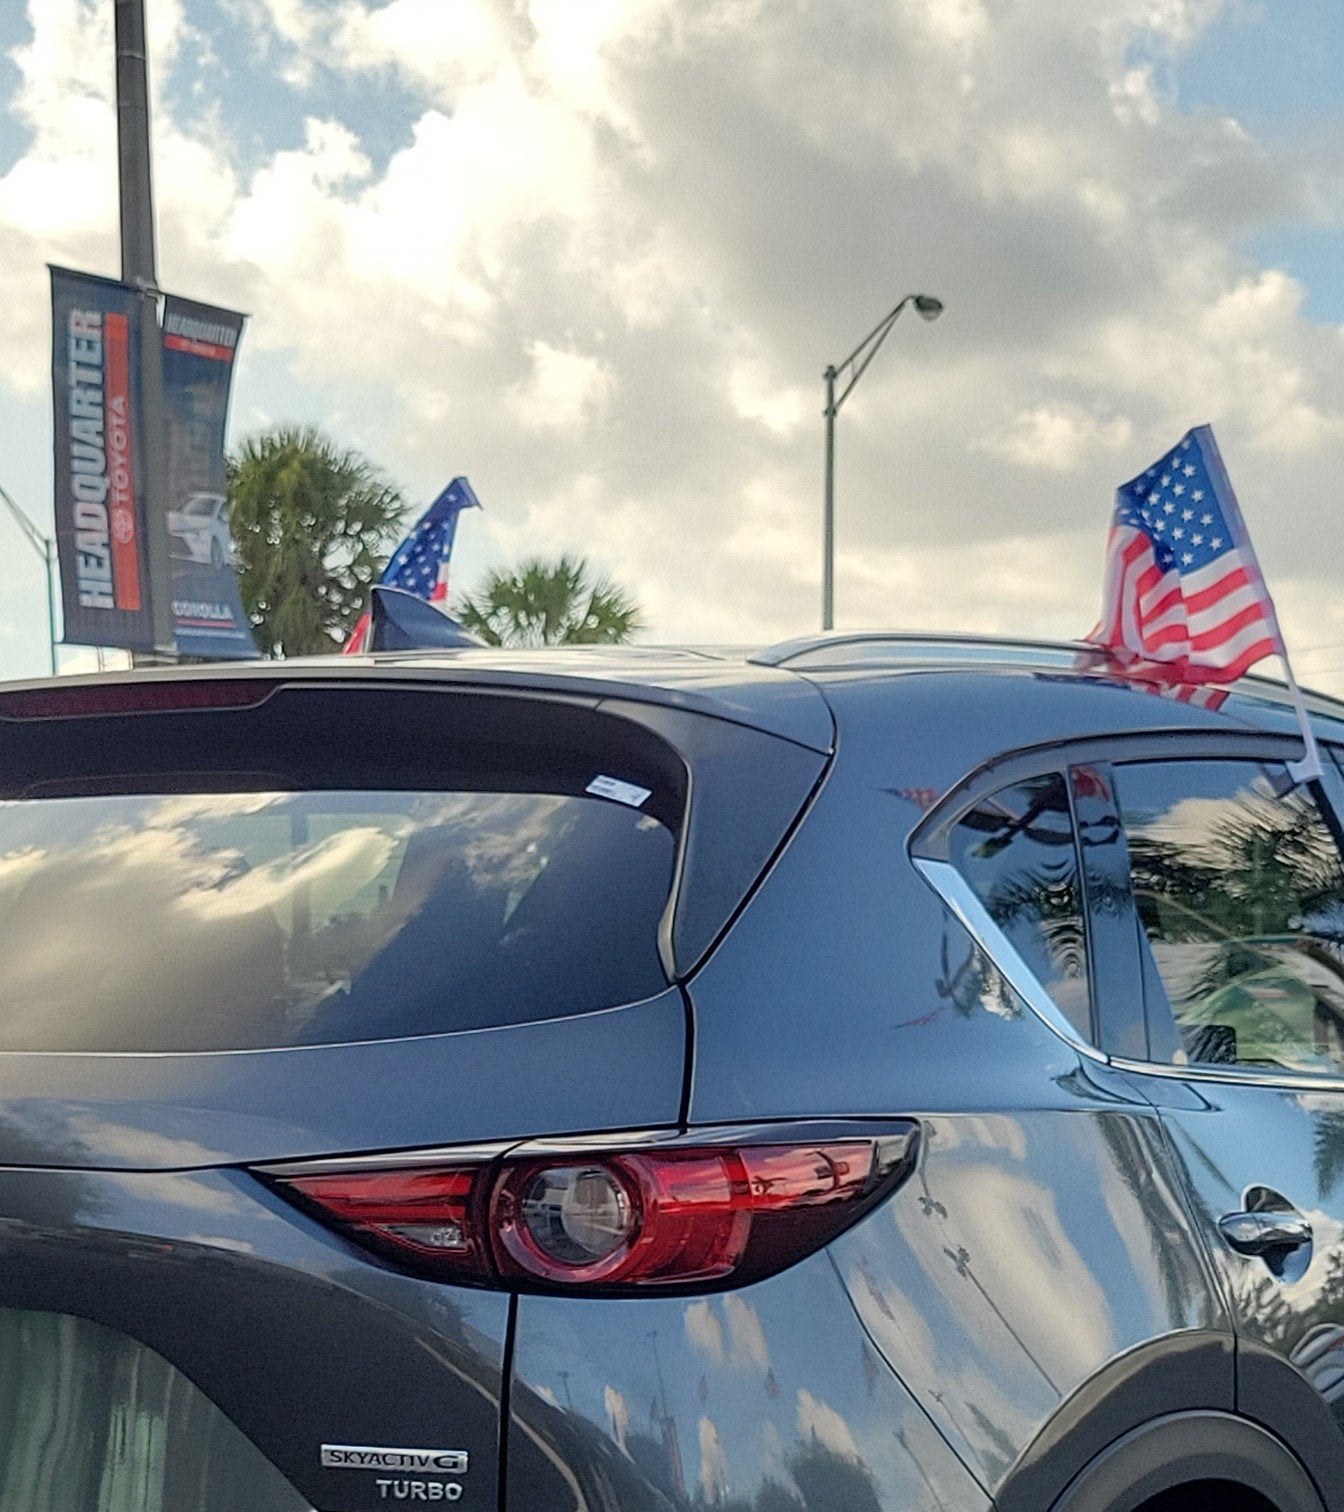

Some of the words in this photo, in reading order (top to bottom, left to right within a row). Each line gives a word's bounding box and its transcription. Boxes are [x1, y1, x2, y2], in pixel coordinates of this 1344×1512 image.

[70, 310, 115, 610] HEADQUARTER
[107, 394, 131, 502] TOYOTA
[375, 1479, 463, 1500] TURBO
